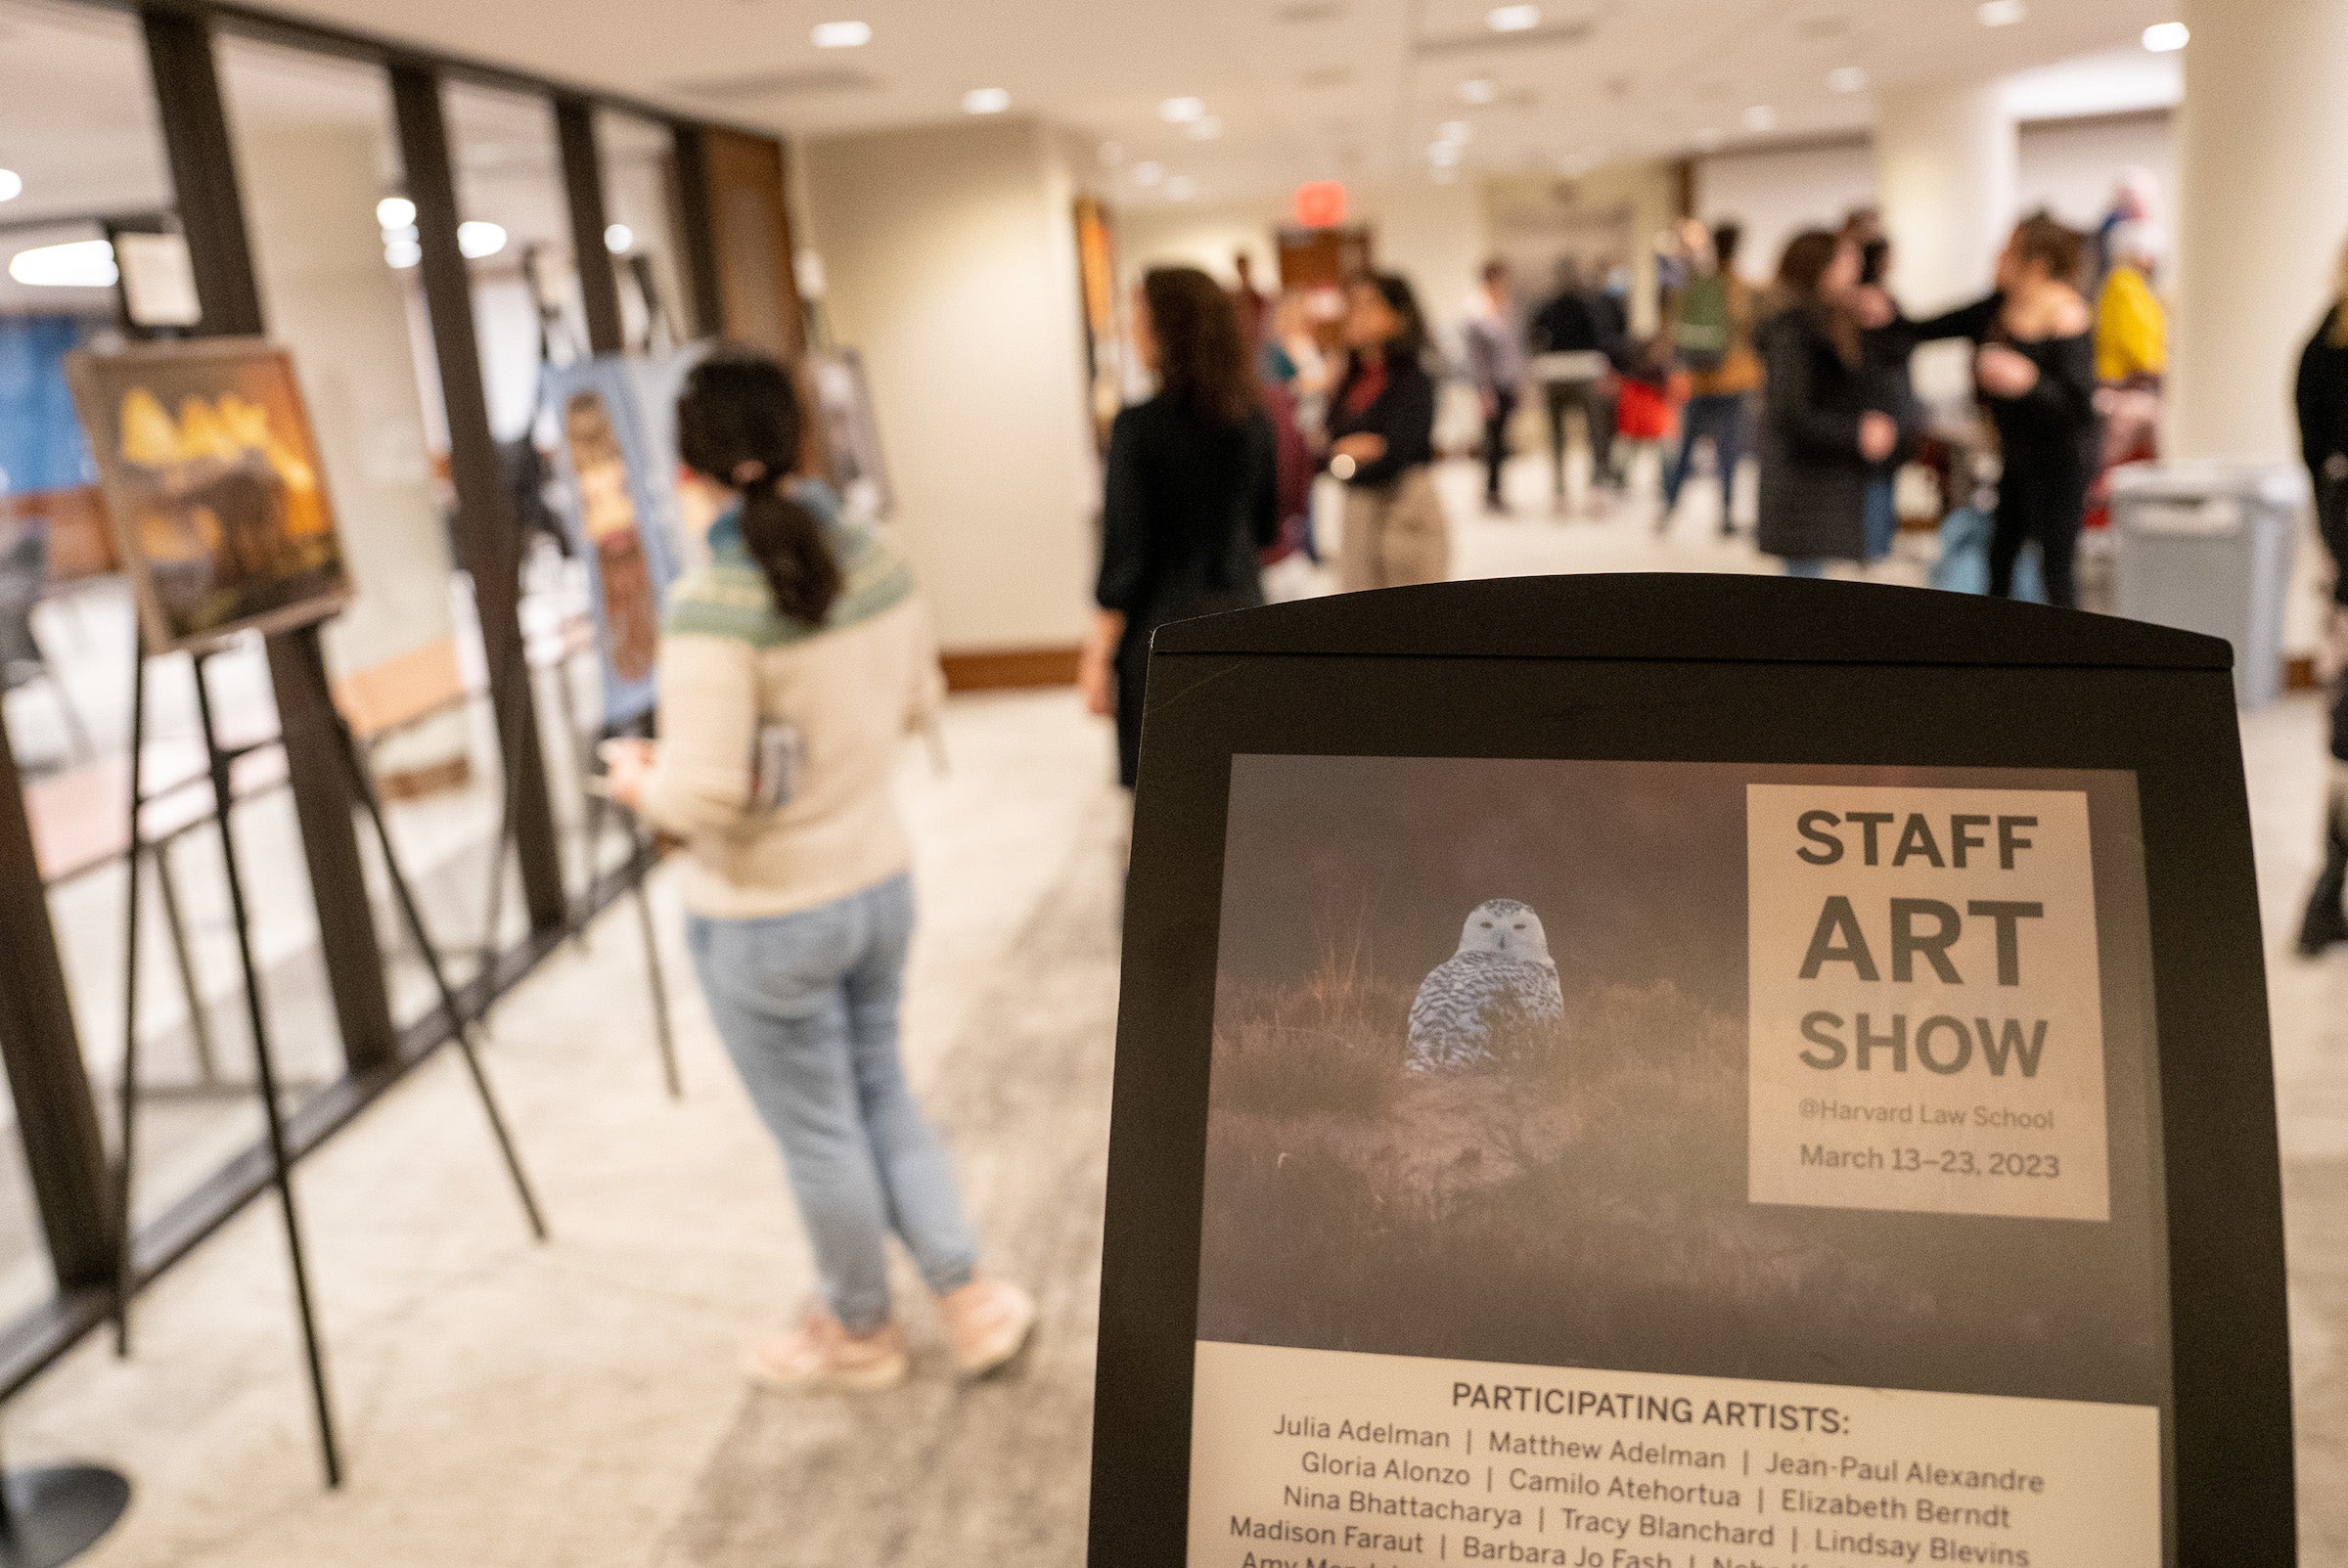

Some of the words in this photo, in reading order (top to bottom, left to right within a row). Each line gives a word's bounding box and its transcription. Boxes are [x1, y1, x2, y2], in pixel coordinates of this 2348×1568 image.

[1797, 810, 2037, 871] STAFF
[1799, 895, 2044, 987] ART
[1800, 1010, 2048, 1078] SHOW
[1919, 1103, 1967, 1126] Law
[1972, 1104, 2055, 1130] School
[1799, 1142, 1885, 1170] March
[1988, 1151, 2061, 1180] 2023
[1451, 1381, 1694, 1425] PARTICIPATING
[1701, 1400, 1850, 1436] ARTISTS:
[1273, 1413, 1332, 1439] Julia
[1337, 1418, 1451, 1448] Adelman
[1488, 1430, 1603, 1460] Matthew
[1609, 1439, 1727, 1469] Adelman
[1765, 1452, 1898, 1482] Jean-Paul
[1906, 1460, 2046, 1495] Alexandre
[1300, 1451, 1377, 1478] Gloria
[1383, 1458, 1471, 1487] Alonzo
[1508, 1467, 1601, 1497] Camilo
[1606, 1476, 1741, 1508] Atehortua
[1781, 1488, 1908, 1519] Elizabeth
[1916, 1499, 2010, 1529] Berndt
[1229, 1514, 1336, 1546] Madison
[1343, 1525, 1423, 1554] Faraut
[1463, 1535, 1566, 1566] Barbara
[1574, 1546, 1604, 1568] Jo
[1284, 1484, 1341, 1511] Nina
[1348, 1490, 1523, 1530] Bhattacharya
[1561, 1507, 1631, 1540] Tracy
[1639, 1513, 1776, 1547] Blanchard
[1815, 1529, 1920, 1563] Lindsay
[1929, 1537, 2031, 1568] Blevins
